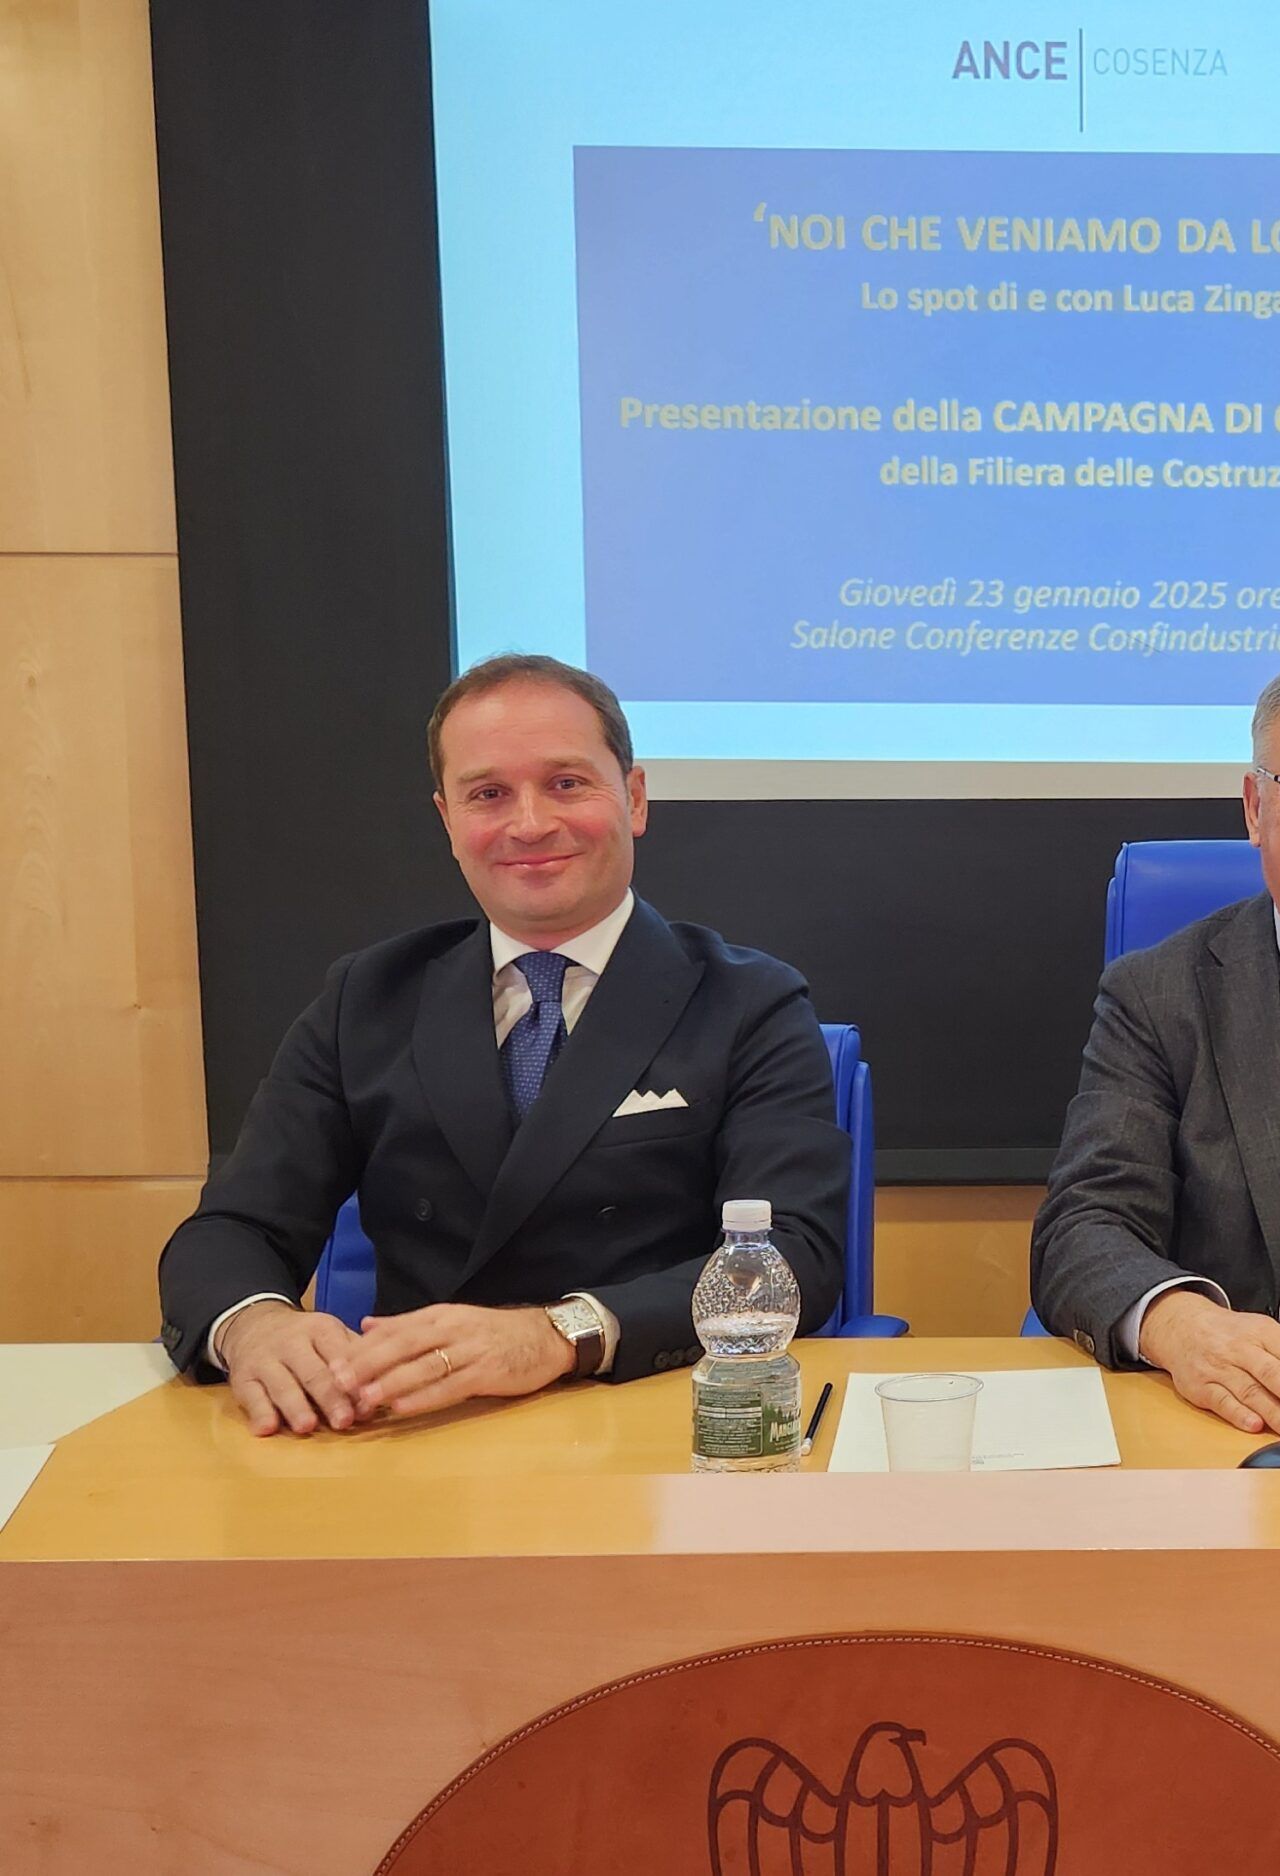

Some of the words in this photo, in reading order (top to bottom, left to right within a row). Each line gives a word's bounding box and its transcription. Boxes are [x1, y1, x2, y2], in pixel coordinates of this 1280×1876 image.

[951, 40, 1068, 80] ANCE
[1093, 48, 1228, 77] COSENZA
[861, 216, 942, 251] CHE
[956, 217, 1161, 254] VENIAMO
[1177, 219, 1236, 254] DA
[861, 283, 898, 311] Lo
[907, 284, 978, 316] spot
[987, 284, 1018, 311] di
[1028, 290, 1046, 312] e
[1056, 290, 1113, 312] con
[1123, 285, 1195, 312] Luca
[619, 397, 881, 431] Presentazione
[892, 400, 982, 432] della
[993, 401, 1214, 433] CAMPAGNA
[1225, 403, 1263, 434] DI
[880, 457, 958, 486] della
[968, 458, 1065, 487] Filiera
[1075, 459, 1154, 488] delle
[839, 579, 957, 608] Giovedì
[965, 580, 1004, 607] 23
[1012, 580, 1140, 614] gennaio
[1150, 581, 1227, 609] 2025
[792, 621, 896, 650] Salone
[905, 622, 1078, 656] Conferenze
